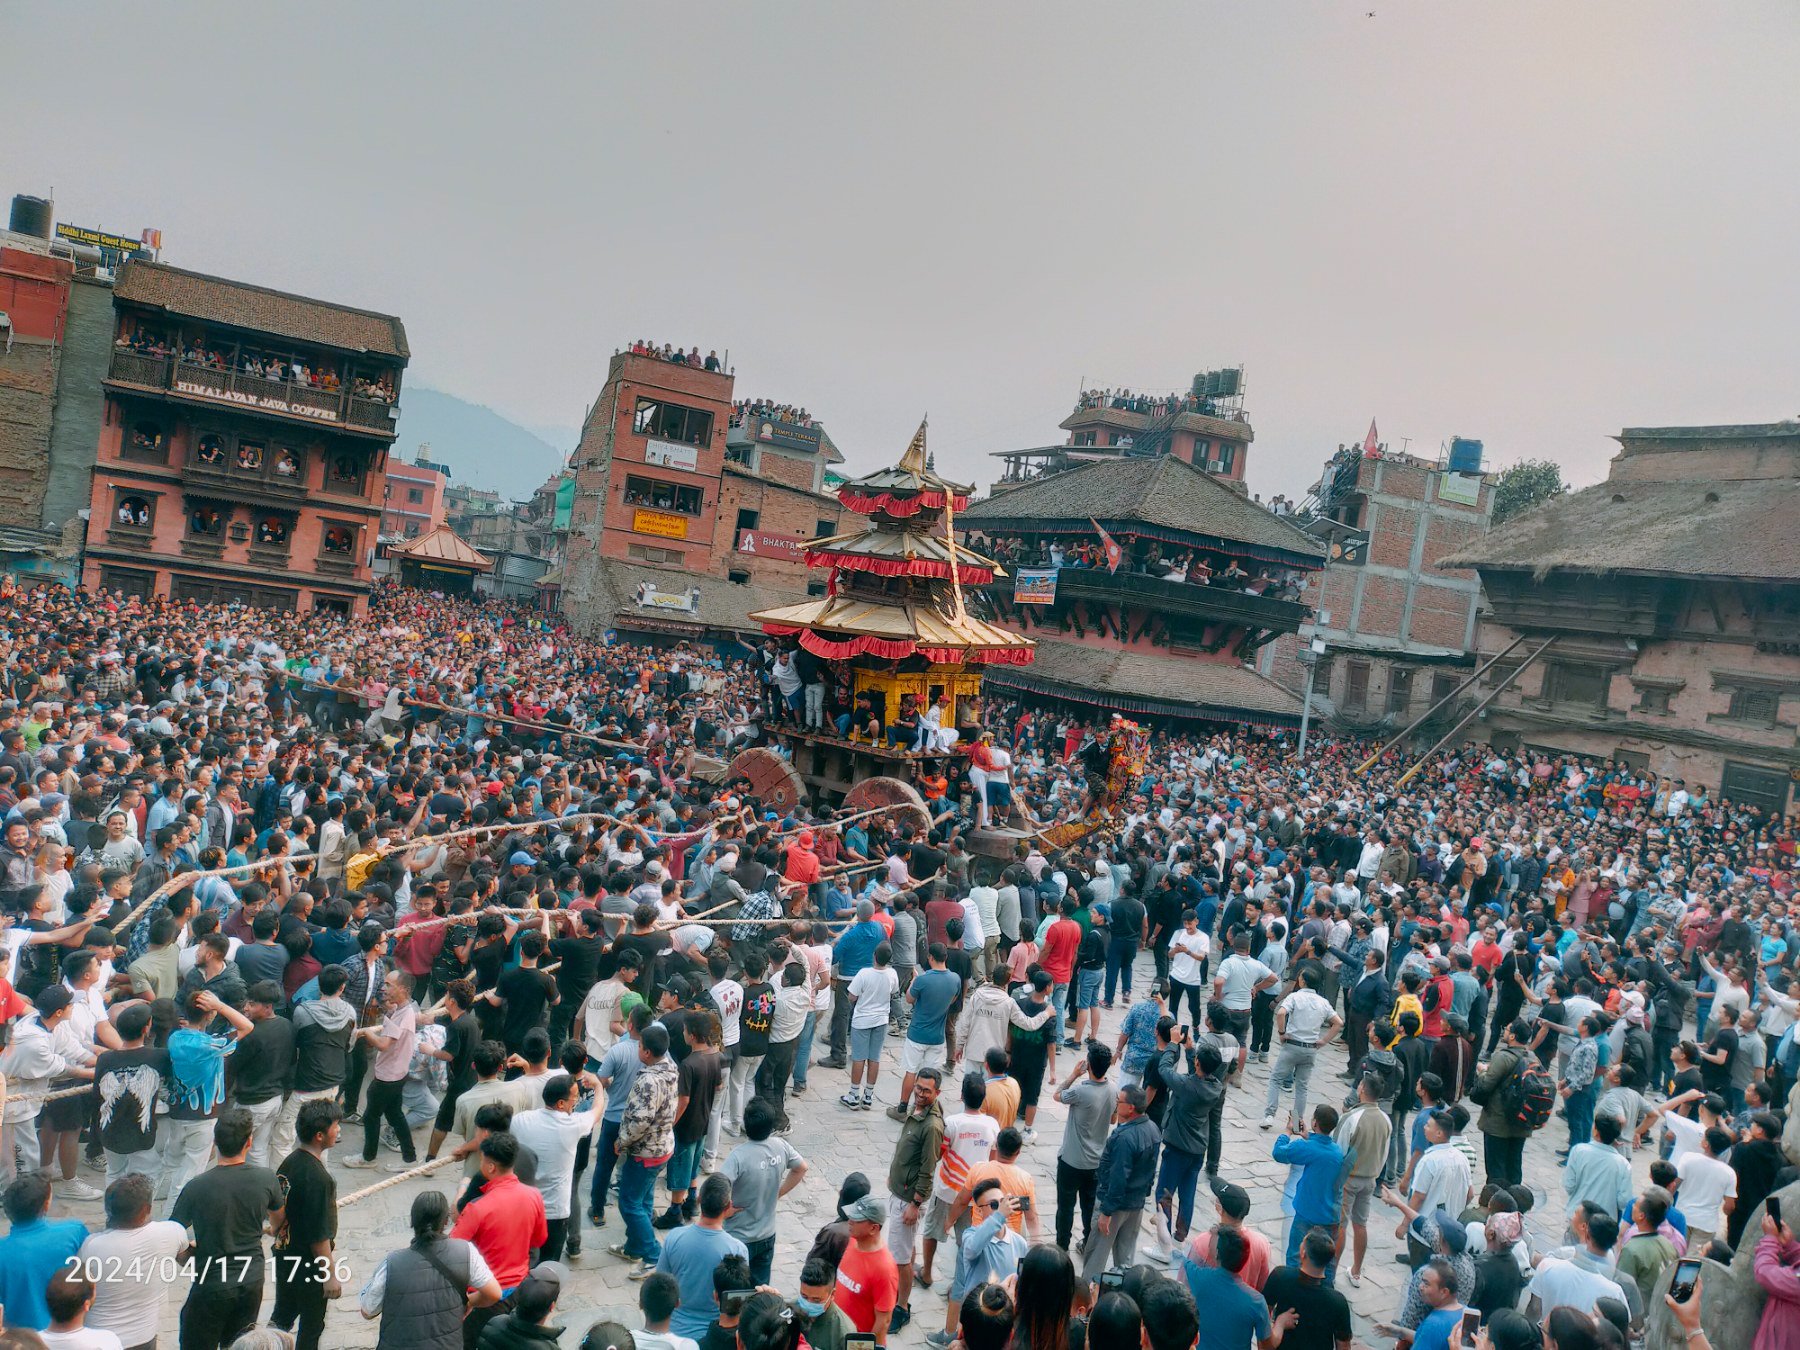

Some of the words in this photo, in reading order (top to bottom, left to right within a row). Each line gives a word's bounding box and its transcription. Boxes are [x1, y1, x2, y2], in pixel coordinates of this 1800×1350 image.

[57, 224, 80, 237] Siddhi
[80, 229, 100, 241] Laxmi
[100, 234, 120, 246] Guest
[119, 238, 140, 250] House
[176, 381, 258, 404] HIMALAYAN
[259, 398, 289, 411] JAVA
[291, 403, 337, 420] COFFEE
